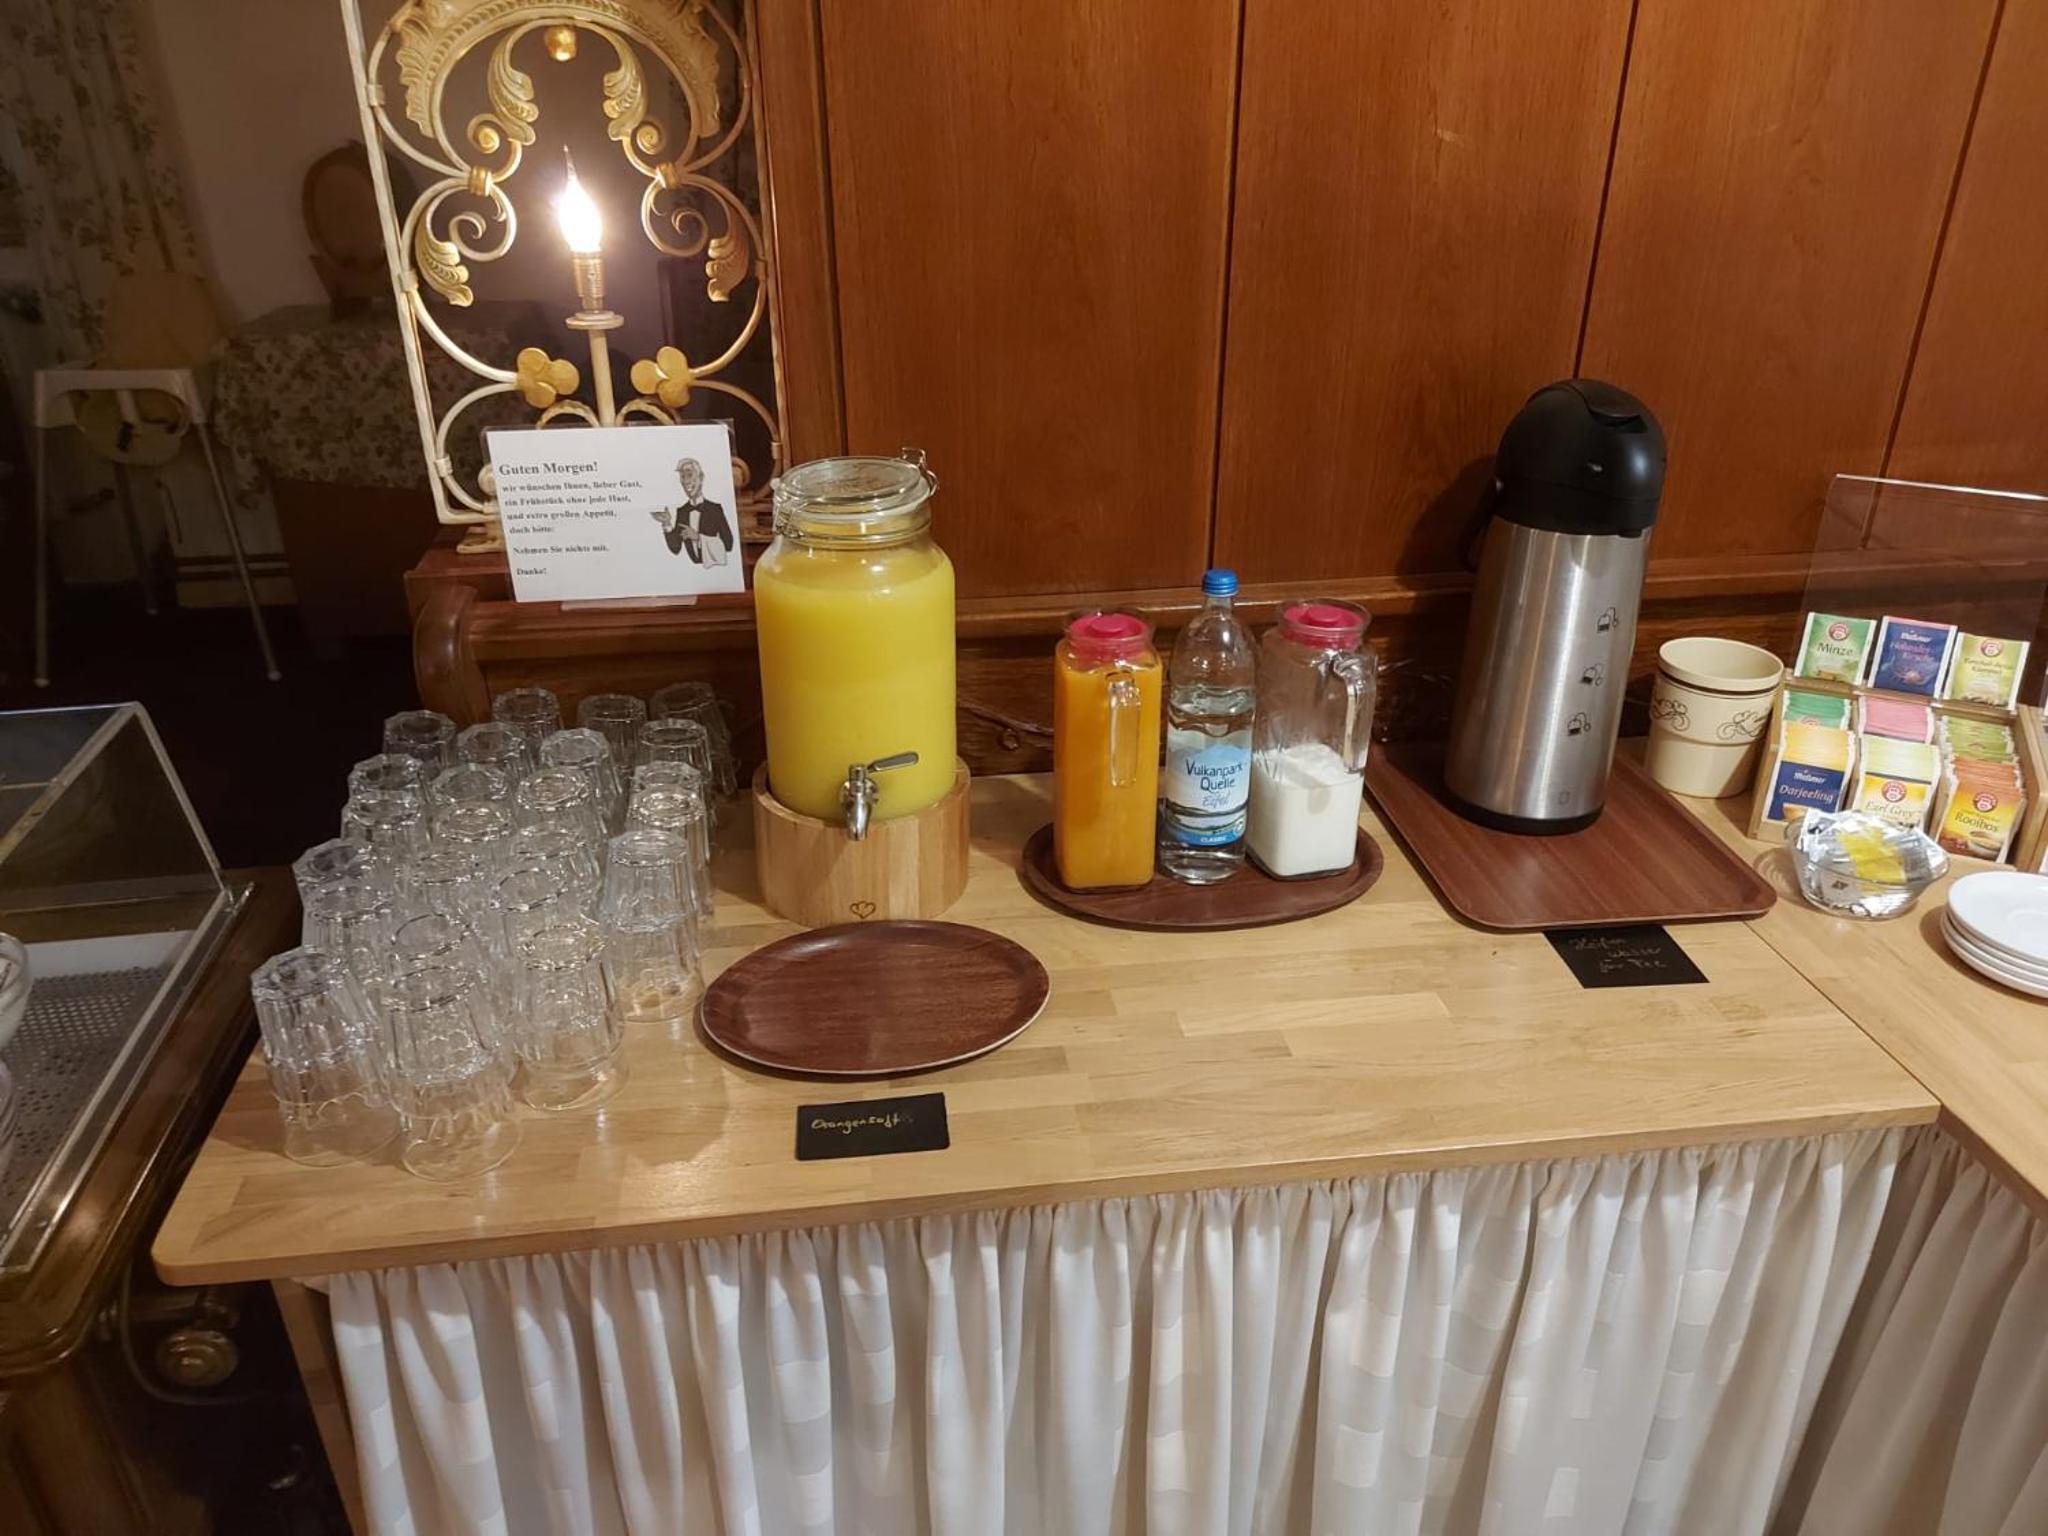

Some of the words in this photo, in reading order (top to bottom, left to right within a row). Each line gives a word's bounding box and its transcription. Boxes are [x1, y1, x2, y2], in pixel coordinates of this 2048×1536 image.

[499, 463, 540, 476] Guten
[543, 461, 599, 476] Morgen!
[520, 483, 562, 492] wünschen
[593, 481, 617, 490] lieber
[520, 497, 565, 507] Frühstück
[566, 496, 587, 504] ohne
[589, 495, 607, 505] jede
[506, 512, 524, 520] und
[509, 526, 531, 534] doch
[513, 547, 549, 555] Nehmen
[565, 545, 591, 553] nichts
[516, 567, 548, 576] Danke!
[1817, 642, 1854, 656] Minze
[1185, 759, 1243, 778] Vulkanpark
[1200, 777, 1236, 793] Quelle
[1780, 785, 1834, 804] Darjeeling
[1865, 802, 1889, 813] Earl
[1890, 804, 1914, 820] Grey
[1955, 812, 1999, 832] Rooibos
